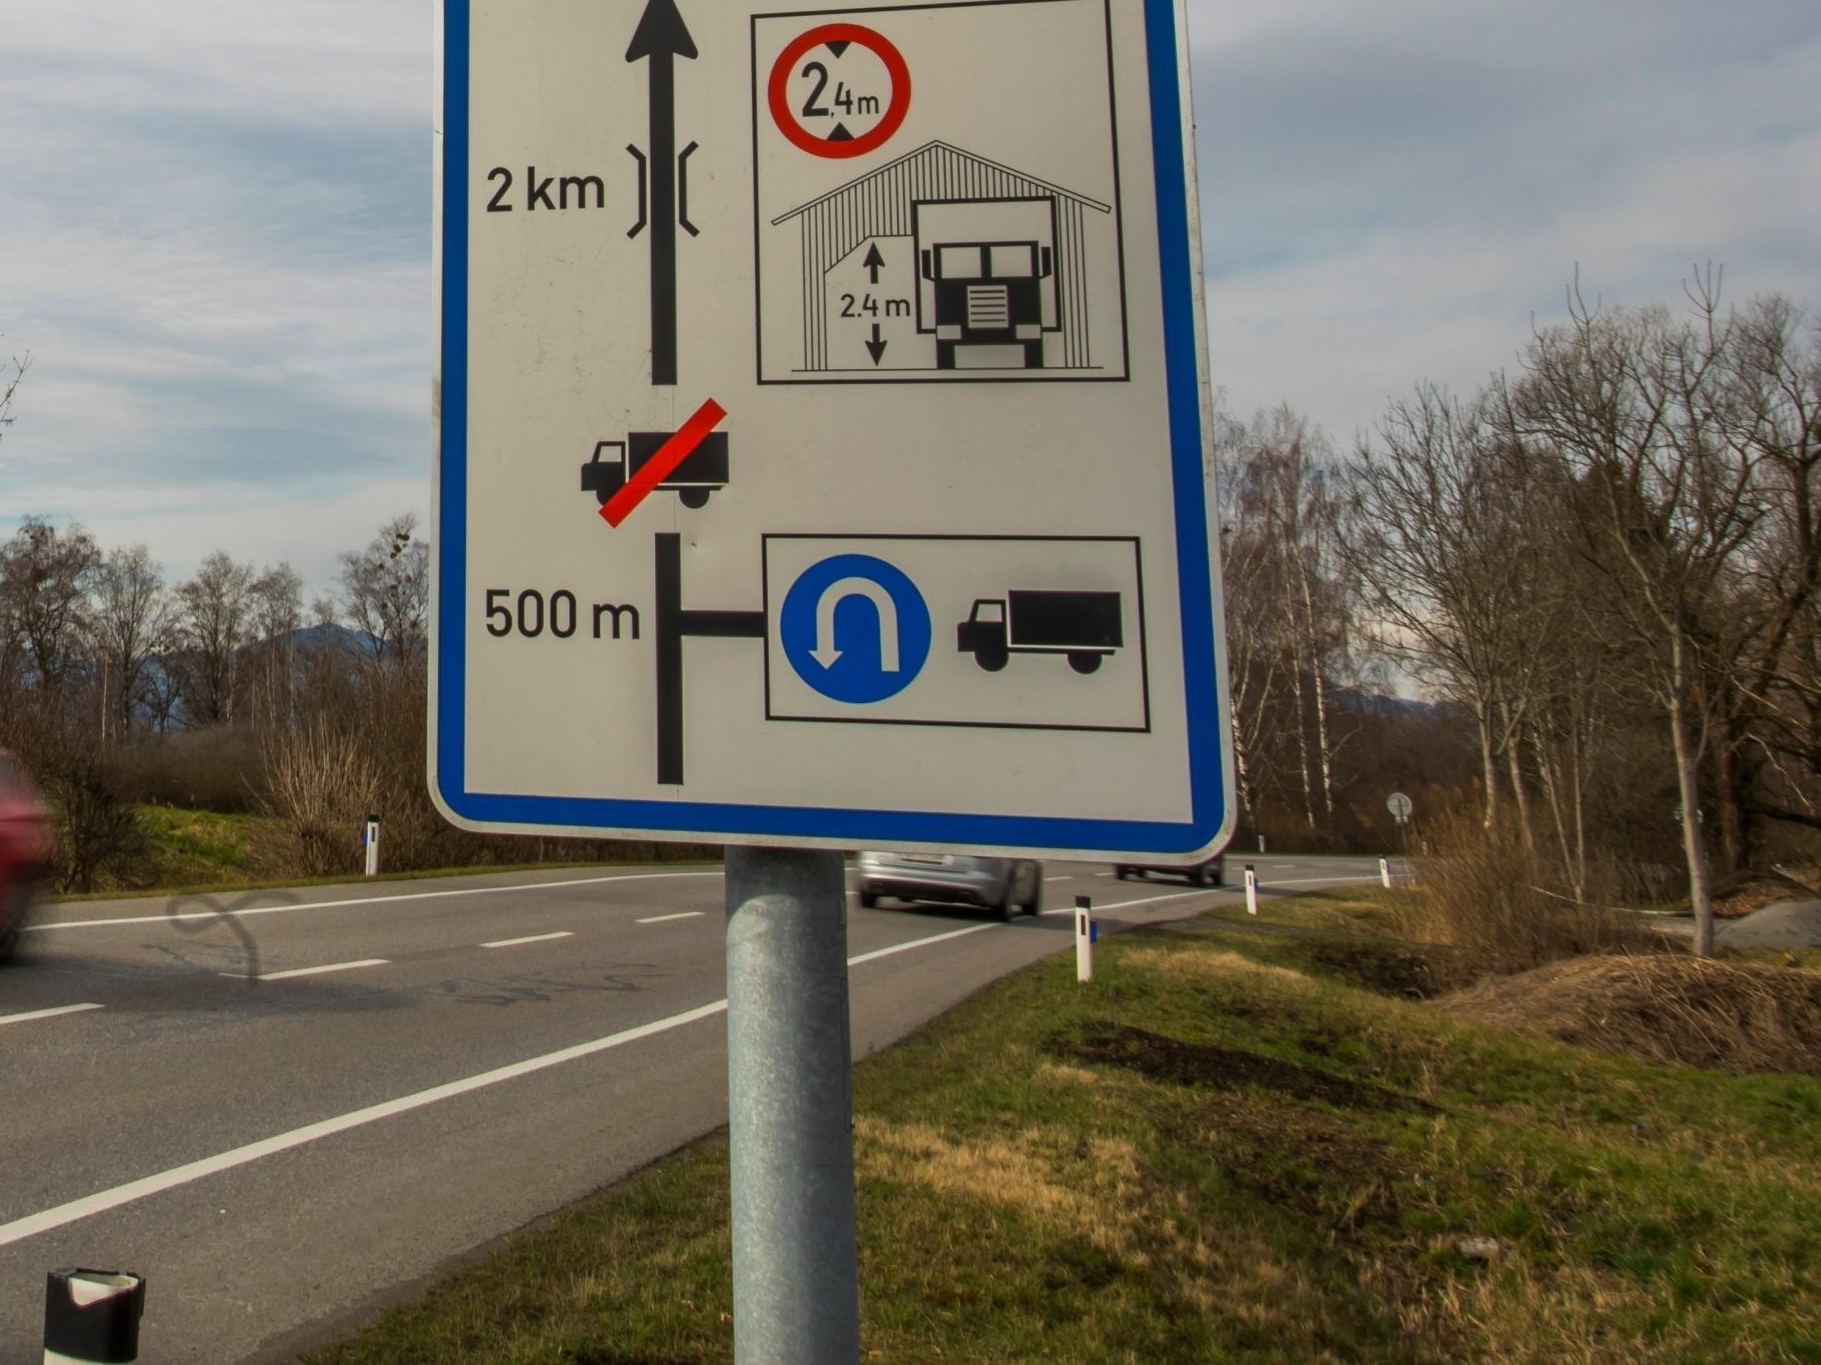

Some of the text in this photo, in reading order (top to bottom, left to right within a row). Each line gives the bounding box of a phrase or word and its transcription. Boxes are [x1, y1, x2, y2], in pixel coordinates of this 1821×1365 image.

[485, 165, 606, 213] 2 km
[840, 293, 911, 318] 2.4 m
[485, 588, 641, 640] 500 m
